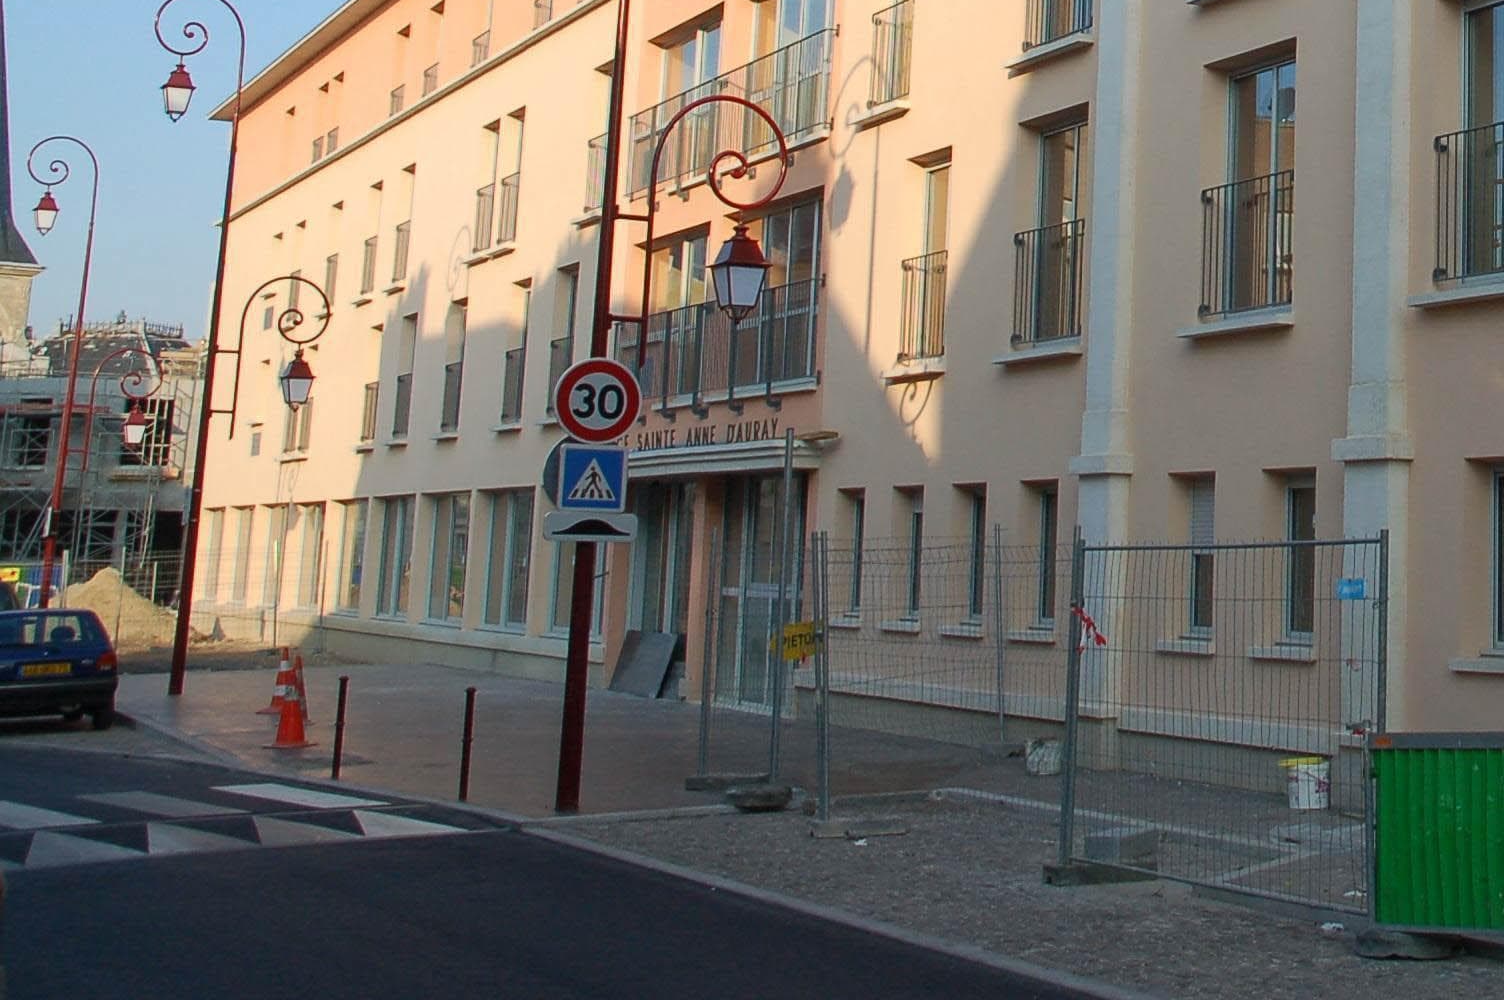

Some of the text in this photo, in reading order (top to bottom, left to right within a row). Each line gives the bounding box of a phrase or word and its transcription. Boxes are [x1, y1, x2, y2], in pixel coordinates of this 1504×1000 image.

[573, 383, 624, 419] 30
[637, 429, 676, 451] SAINTE
[686, 425, 716, 446] ANNE
[727, 417, 779, 443] D'AURAY
